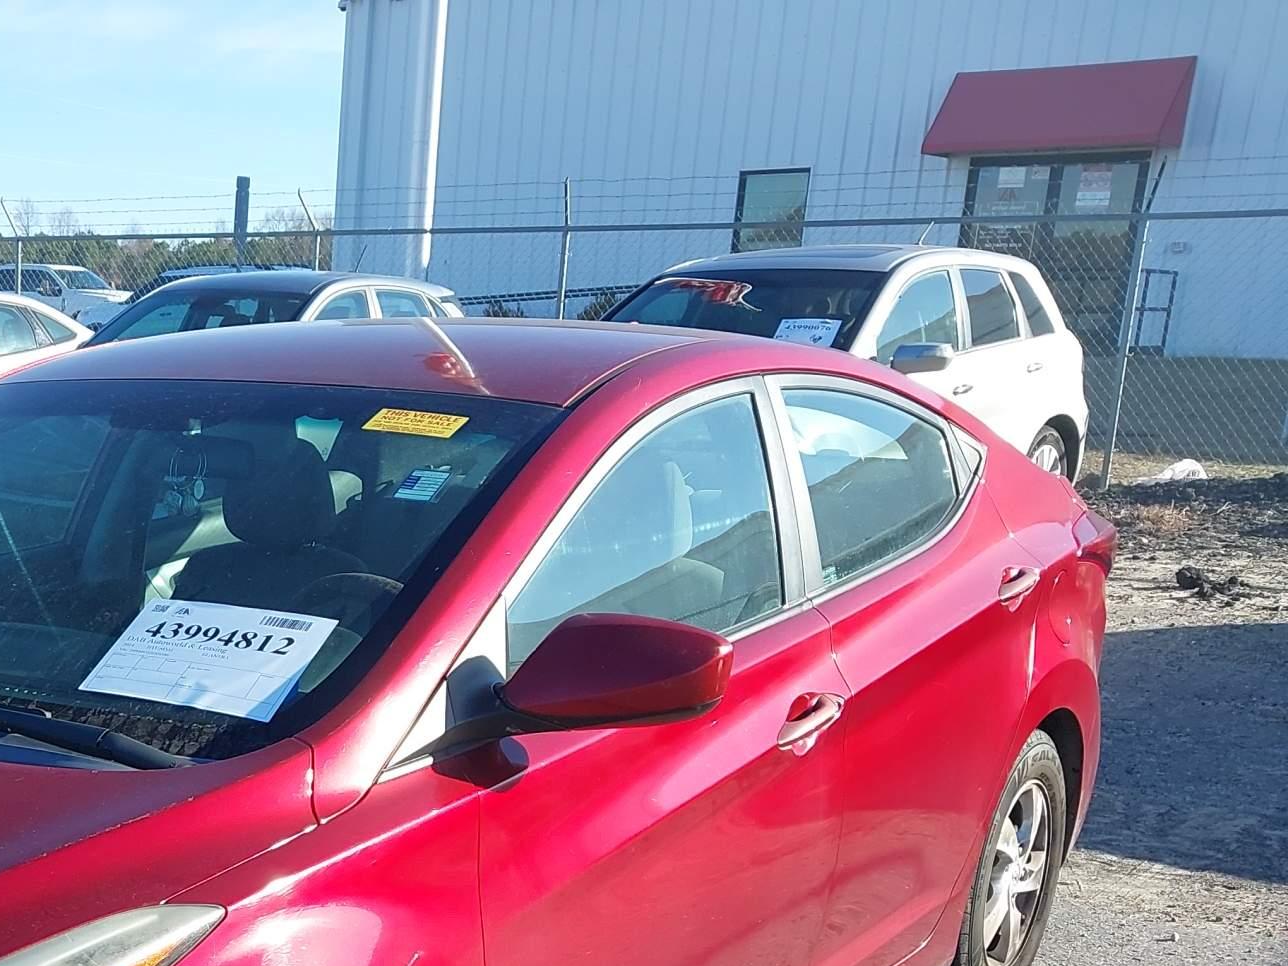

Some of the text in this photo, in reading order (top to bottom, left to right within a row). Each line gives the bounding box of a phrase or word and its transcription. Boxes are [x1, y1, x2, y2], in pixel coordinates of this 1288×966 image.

[380, 414, 403, 422] NOT
[405, 416, 426, 424] FOR
[427, 418, 454, 427] SALE
[384, 409, 463, 423] THIS VEHICLE
[144, 620, 296, 656] 43994812
